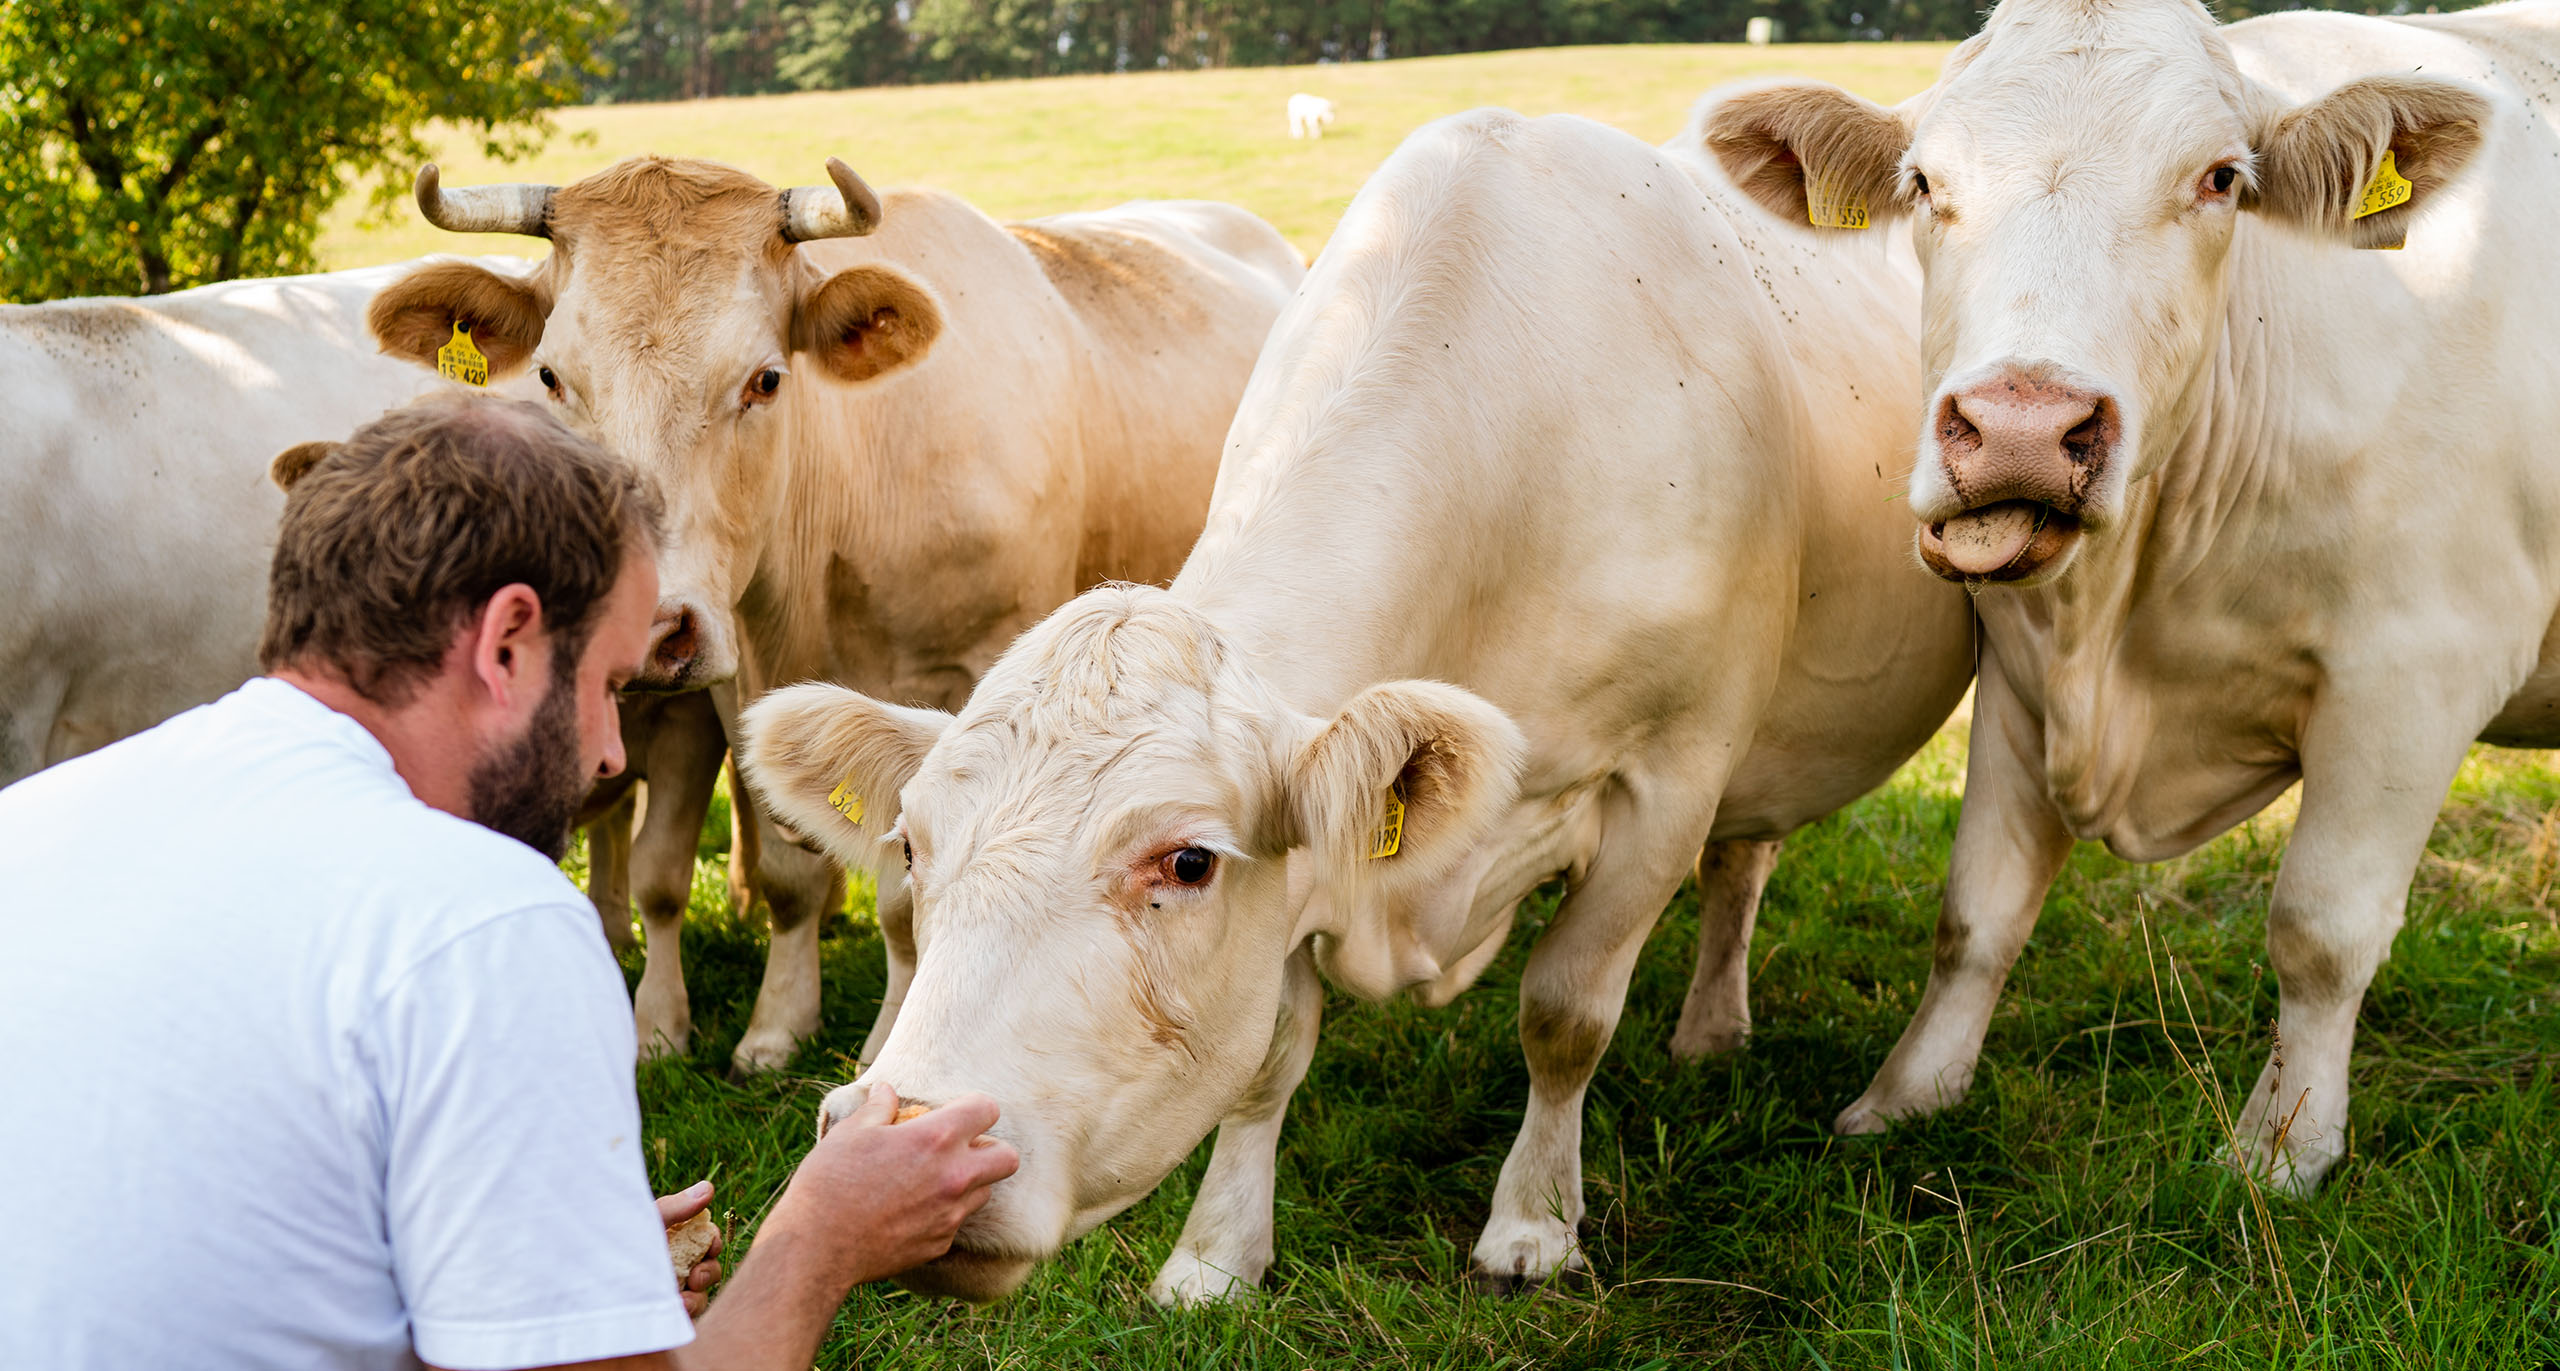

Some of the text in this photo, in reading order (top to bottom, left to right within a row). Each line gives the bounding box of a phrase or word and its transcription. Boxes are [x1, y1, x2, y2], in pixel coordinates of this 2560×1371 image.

[2377, 185, 2405, 208] 559
[1838, 207, 1866, 227] 559
[441, 363, 487, 386] 15 429
